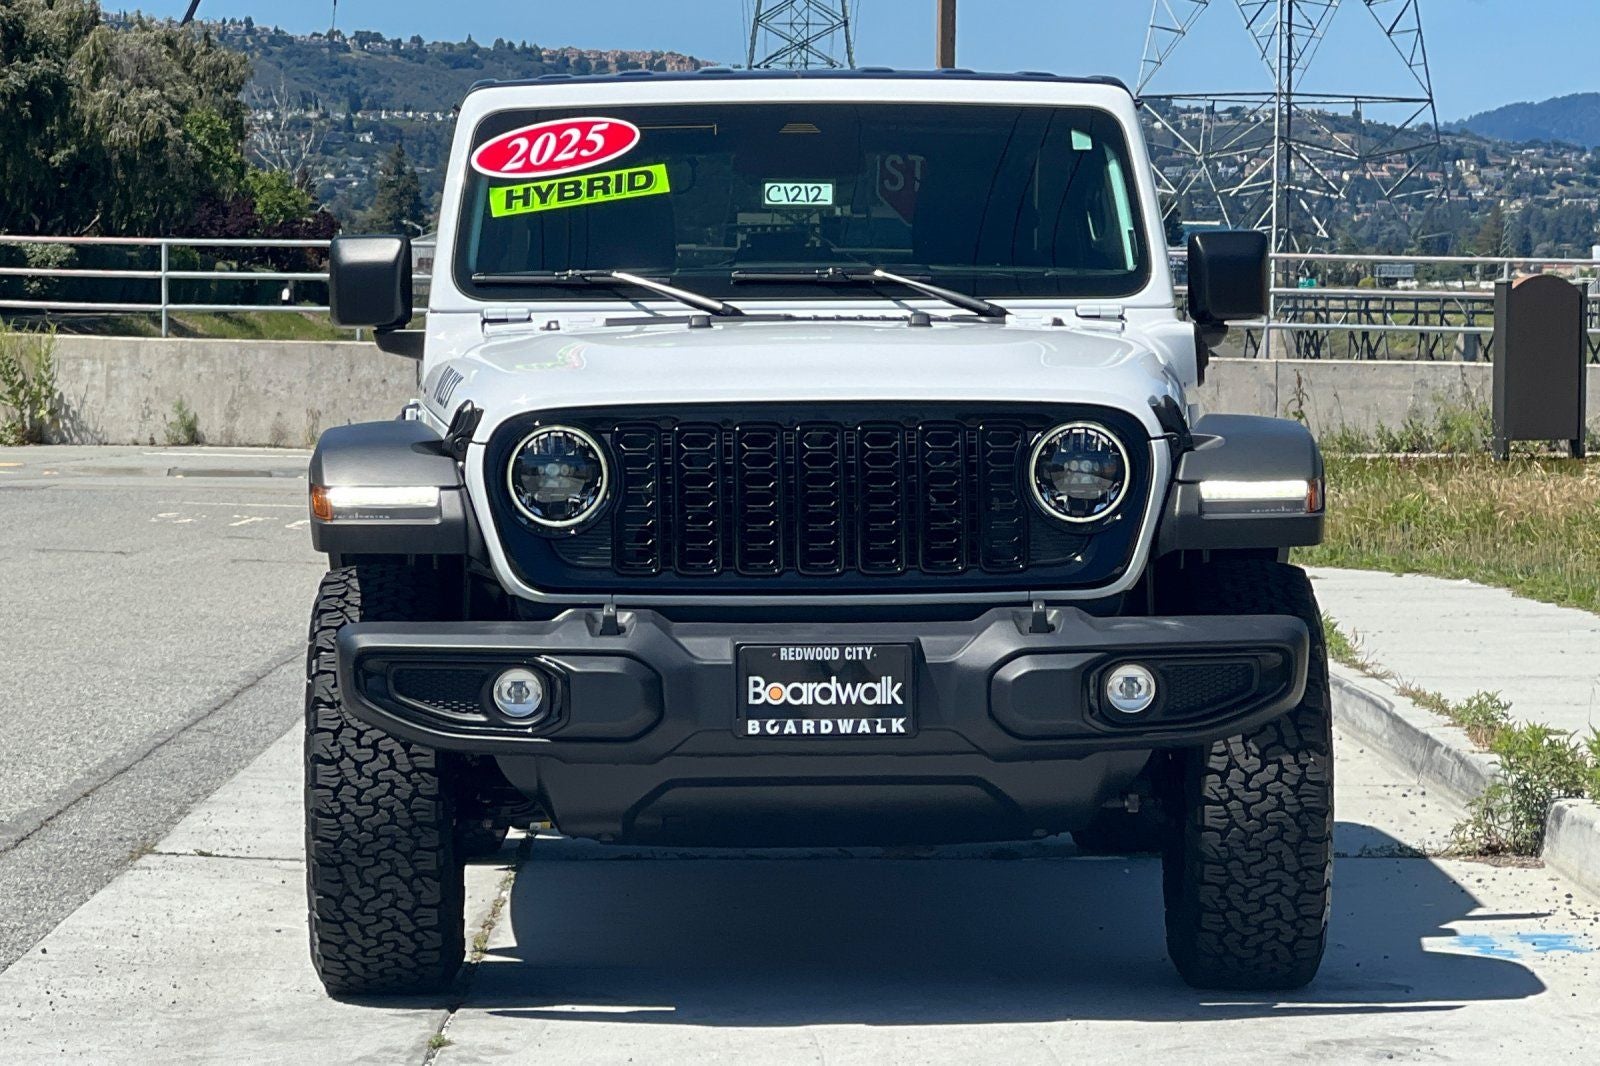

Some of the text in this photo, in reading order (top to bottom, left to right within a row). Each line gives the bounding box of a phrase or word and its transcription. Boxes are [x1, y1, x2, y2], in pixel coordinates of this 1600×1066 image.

[501, 123, 609, 171] 2025
[504, 169, 657, 211] HYBRID
[765, 184, 828, 204] C1212
[780, 646, 873, 661] REDWOOD CITY
[748, 675, 904, 706] Boardwalk
[747, 717, 906, 735] BOARDWALK
